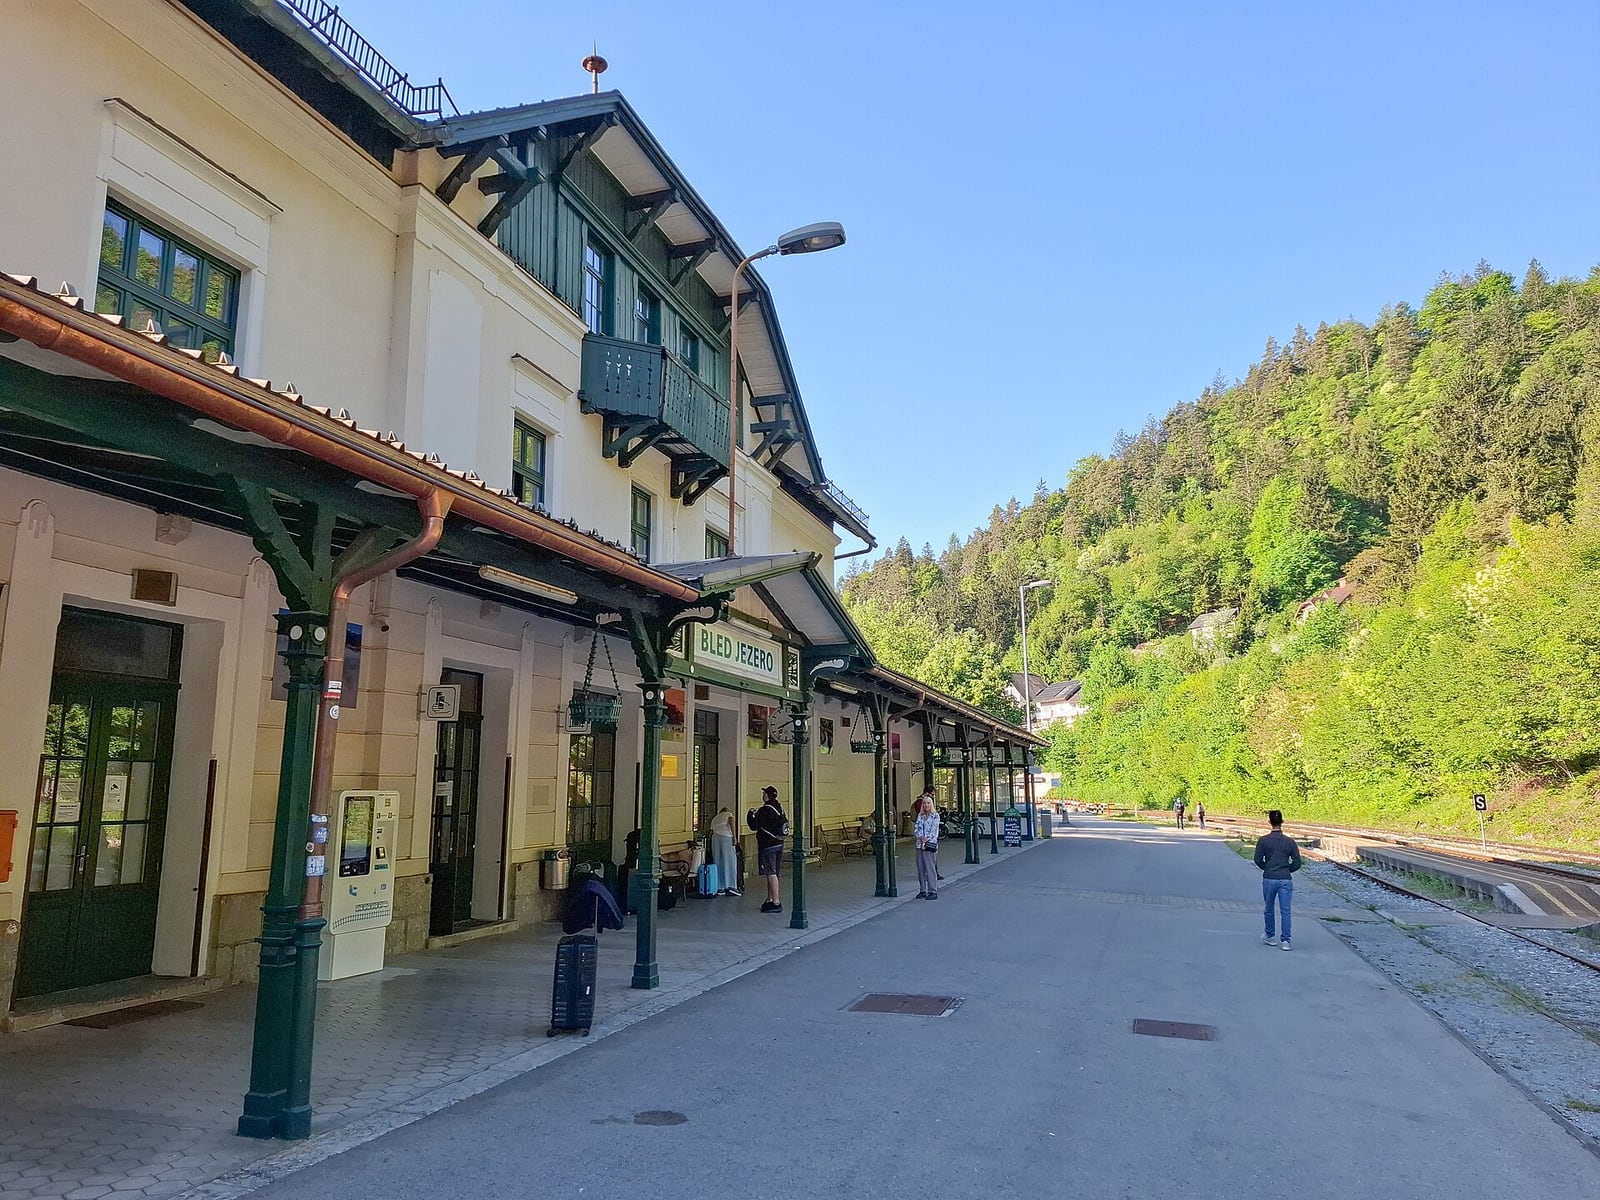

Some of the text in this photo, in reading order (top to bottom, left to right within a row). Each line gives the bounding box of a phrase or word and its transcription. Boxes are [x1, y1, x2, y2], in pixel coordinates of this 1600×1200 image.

[701, 628, 774, 673] BLED JEZERO
[1476, 796, 1485, 809] S
